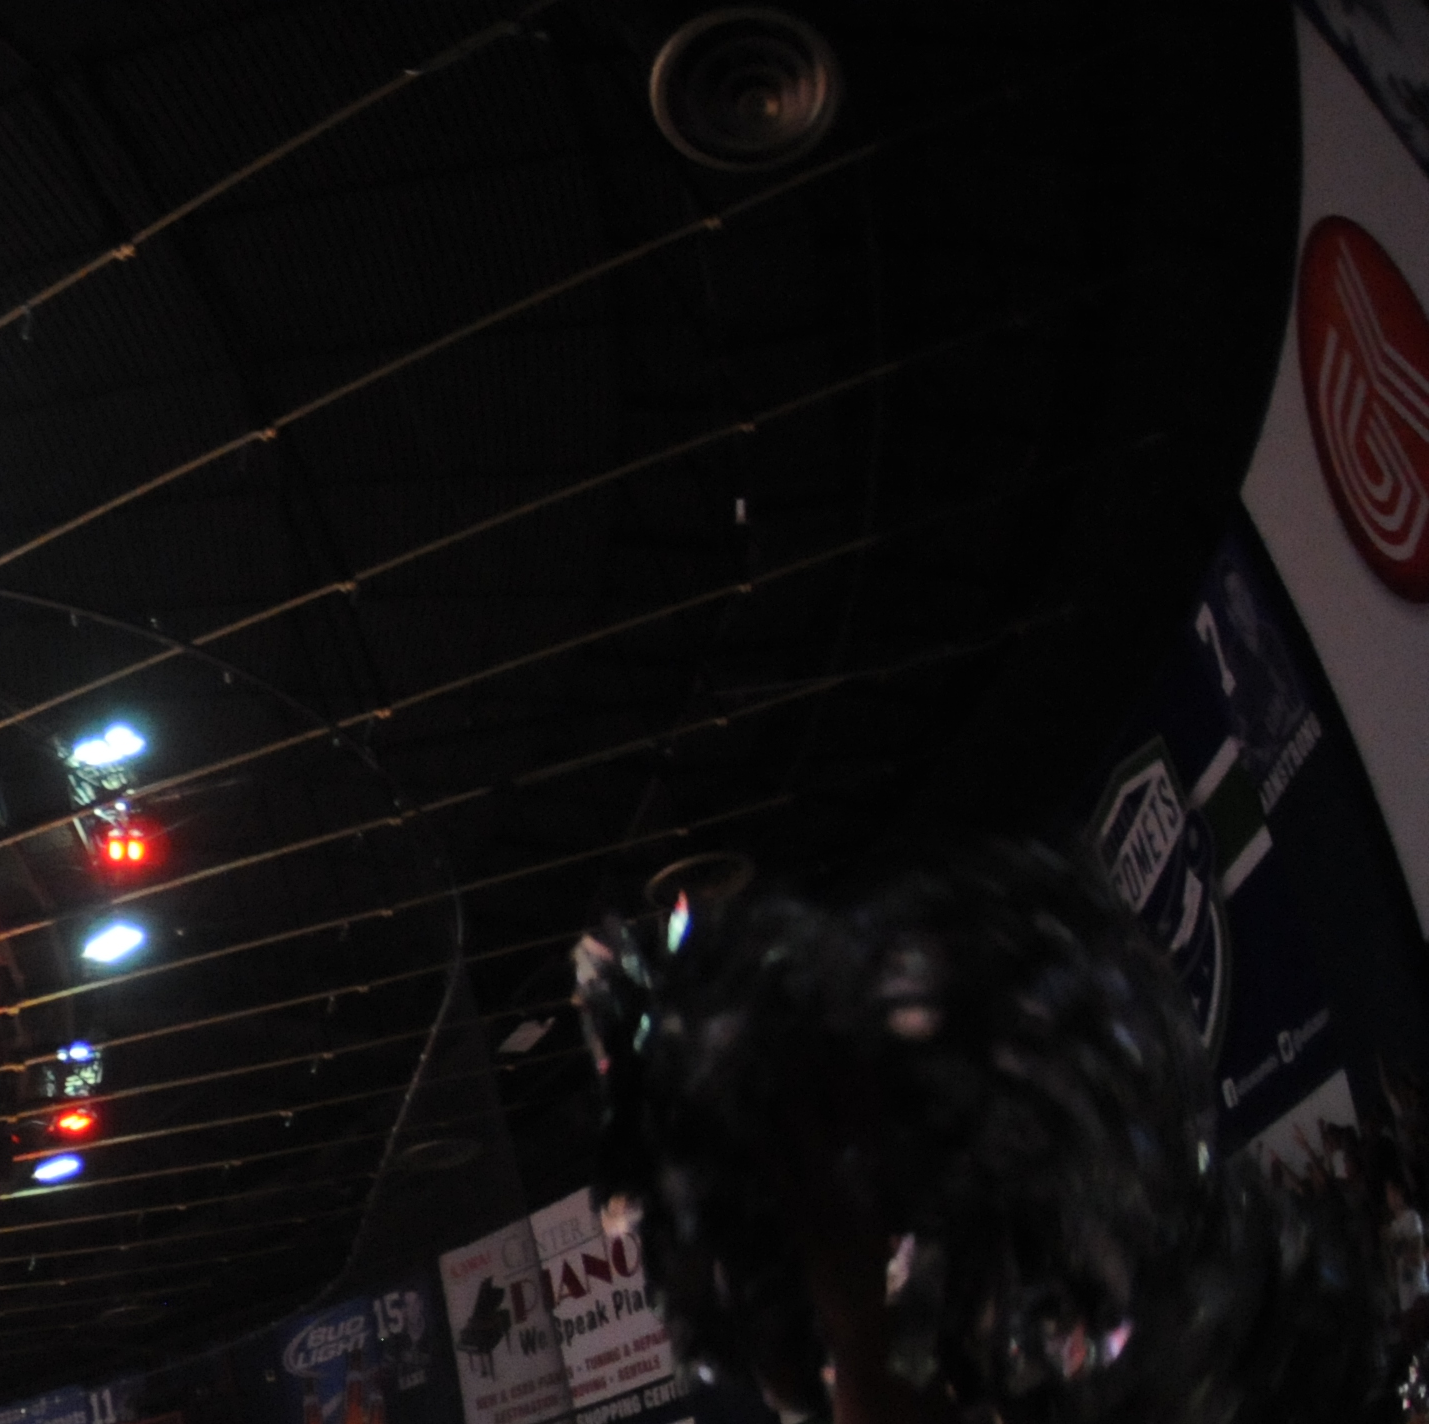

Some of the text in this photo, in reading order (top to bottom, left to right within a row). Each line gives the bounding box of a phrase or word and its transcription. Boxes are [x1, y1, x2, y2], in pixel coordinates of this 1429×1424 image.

[306, 1315, 366, 1349] BUD
[372, 1291, 405, 1340] 15
[554, 1305, 609, 1346] Speak
[296, 1331, 369, 1370] LIGHT
